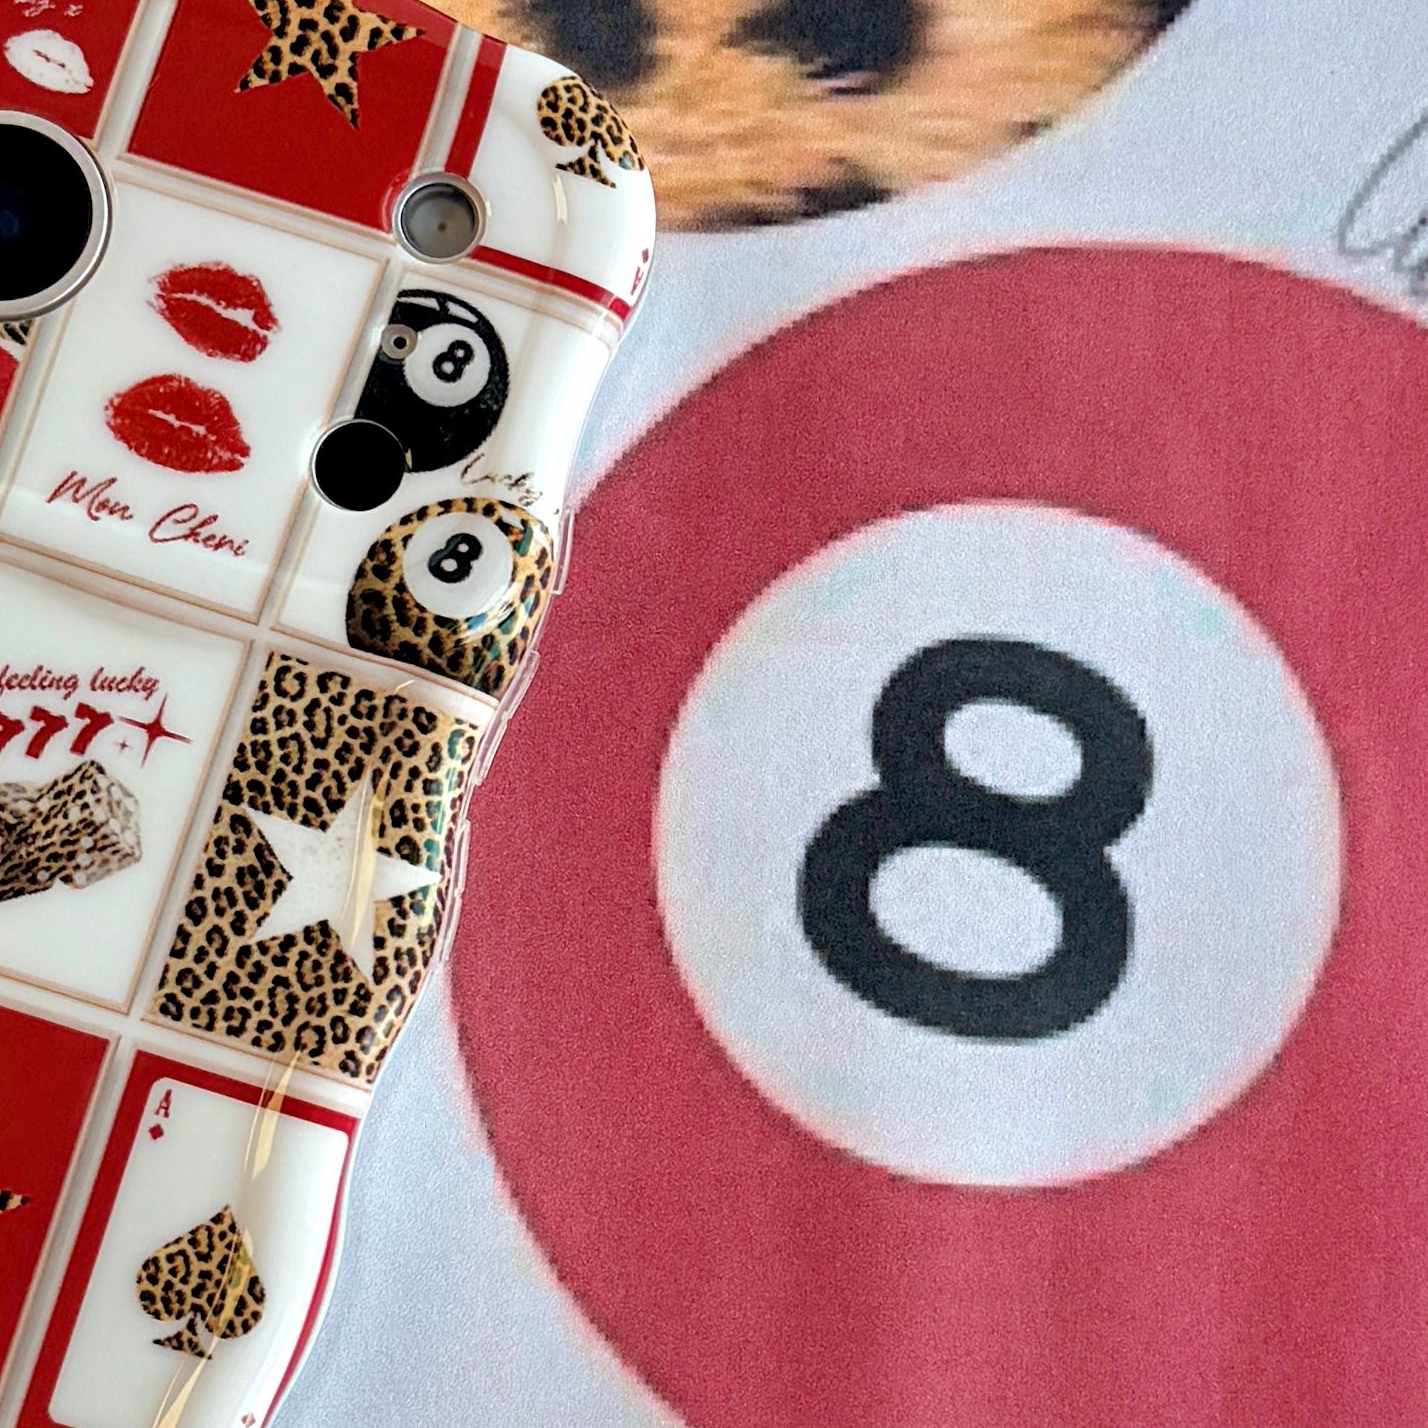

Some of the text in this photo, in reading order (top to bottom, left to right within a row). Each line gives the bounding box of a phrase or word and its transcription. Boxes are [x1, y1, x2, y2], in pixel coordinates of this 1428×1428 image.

[432, 339, 475, 383] 8
[47, 470, 247, 558] Mon Cheri
[428, 533, 483, 584] 8
[88, 667, 160, 698] lucky
[795, 634, 1154, 1043] 8
[154, 1089, 172, 1118] A
